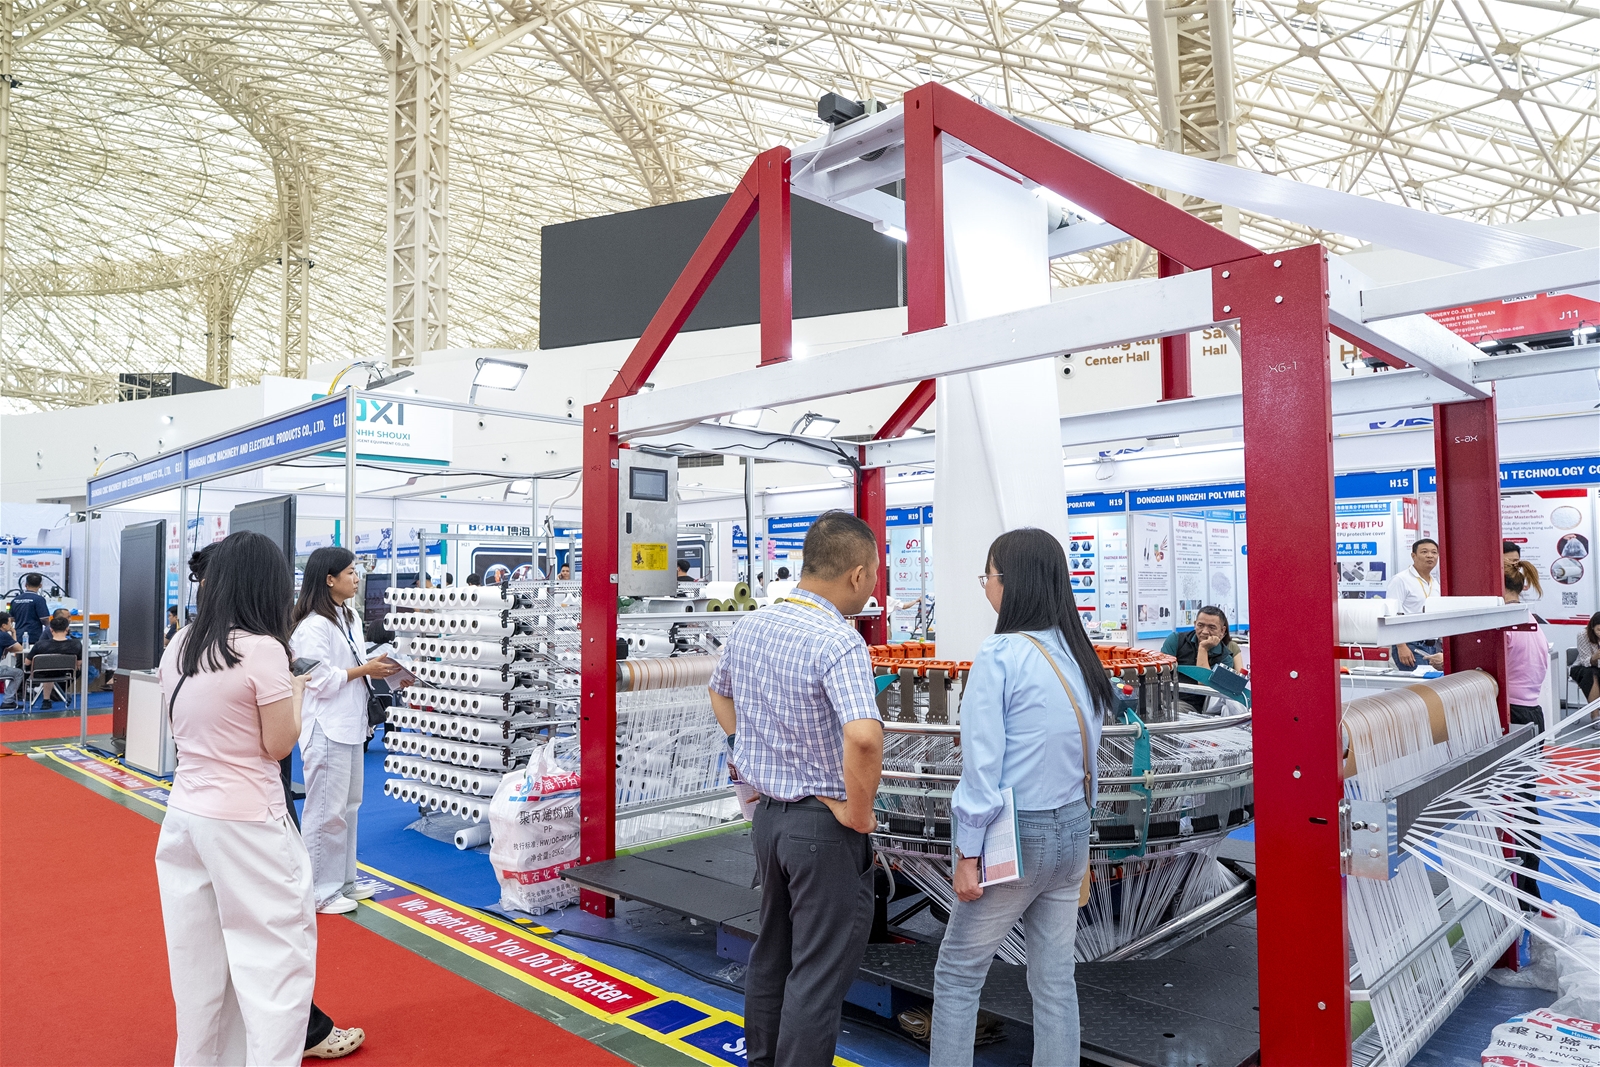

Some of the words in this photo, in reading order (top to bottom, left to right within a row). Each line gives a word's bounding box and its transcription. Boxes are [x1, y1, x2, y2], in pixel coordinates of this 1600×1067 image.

[1559, 309, 1579, 320] J11
[1202, 344, 1227, 356] Hall
[1085, 355, 1123, 367] Center
[1126, 351, 1150, 363] Hall
[1268, 361, 1297, 373] X6-1
[188, 456, 207, 470] SHANGHAI
[216, 445, 239, 461] MACHINERY
[239, 442, 248, 455] AND
[249, 434, 275, 452] ELECTRICAL
[275, 426, 301, 444] PRODUCTS
[313, 419, 326, 433] LTD.
[333, 411, 346, 428] G11
[377, 431, 411, 441] SHOUXI
[1510, 465, 1585, 480] TECHNOLOGY
[1389, 478, 1409, 488] H15
[1109, 498, 1123, 506] H19
[1136, 495, 1175, 504] DONGGUAN
[1176, 492, 1207, 502] DINGZHI
[1208, 489, 1246, 500] POLYMER
[1403, 502, 1418, 525] TPU
[519, 805, 575, 826] 聚丙烯树脂
[543, 825, 553, 833] PP
[397, 898, 429, 912] We
[417, 908, 470, 929] Might
[454, 924, 498, 943] Help
[489, 938, 530, 957] You
[518, 952, 553, 968] Do
[543, 963, 575, 977] It
[560, 971, 633, 1004] Better
